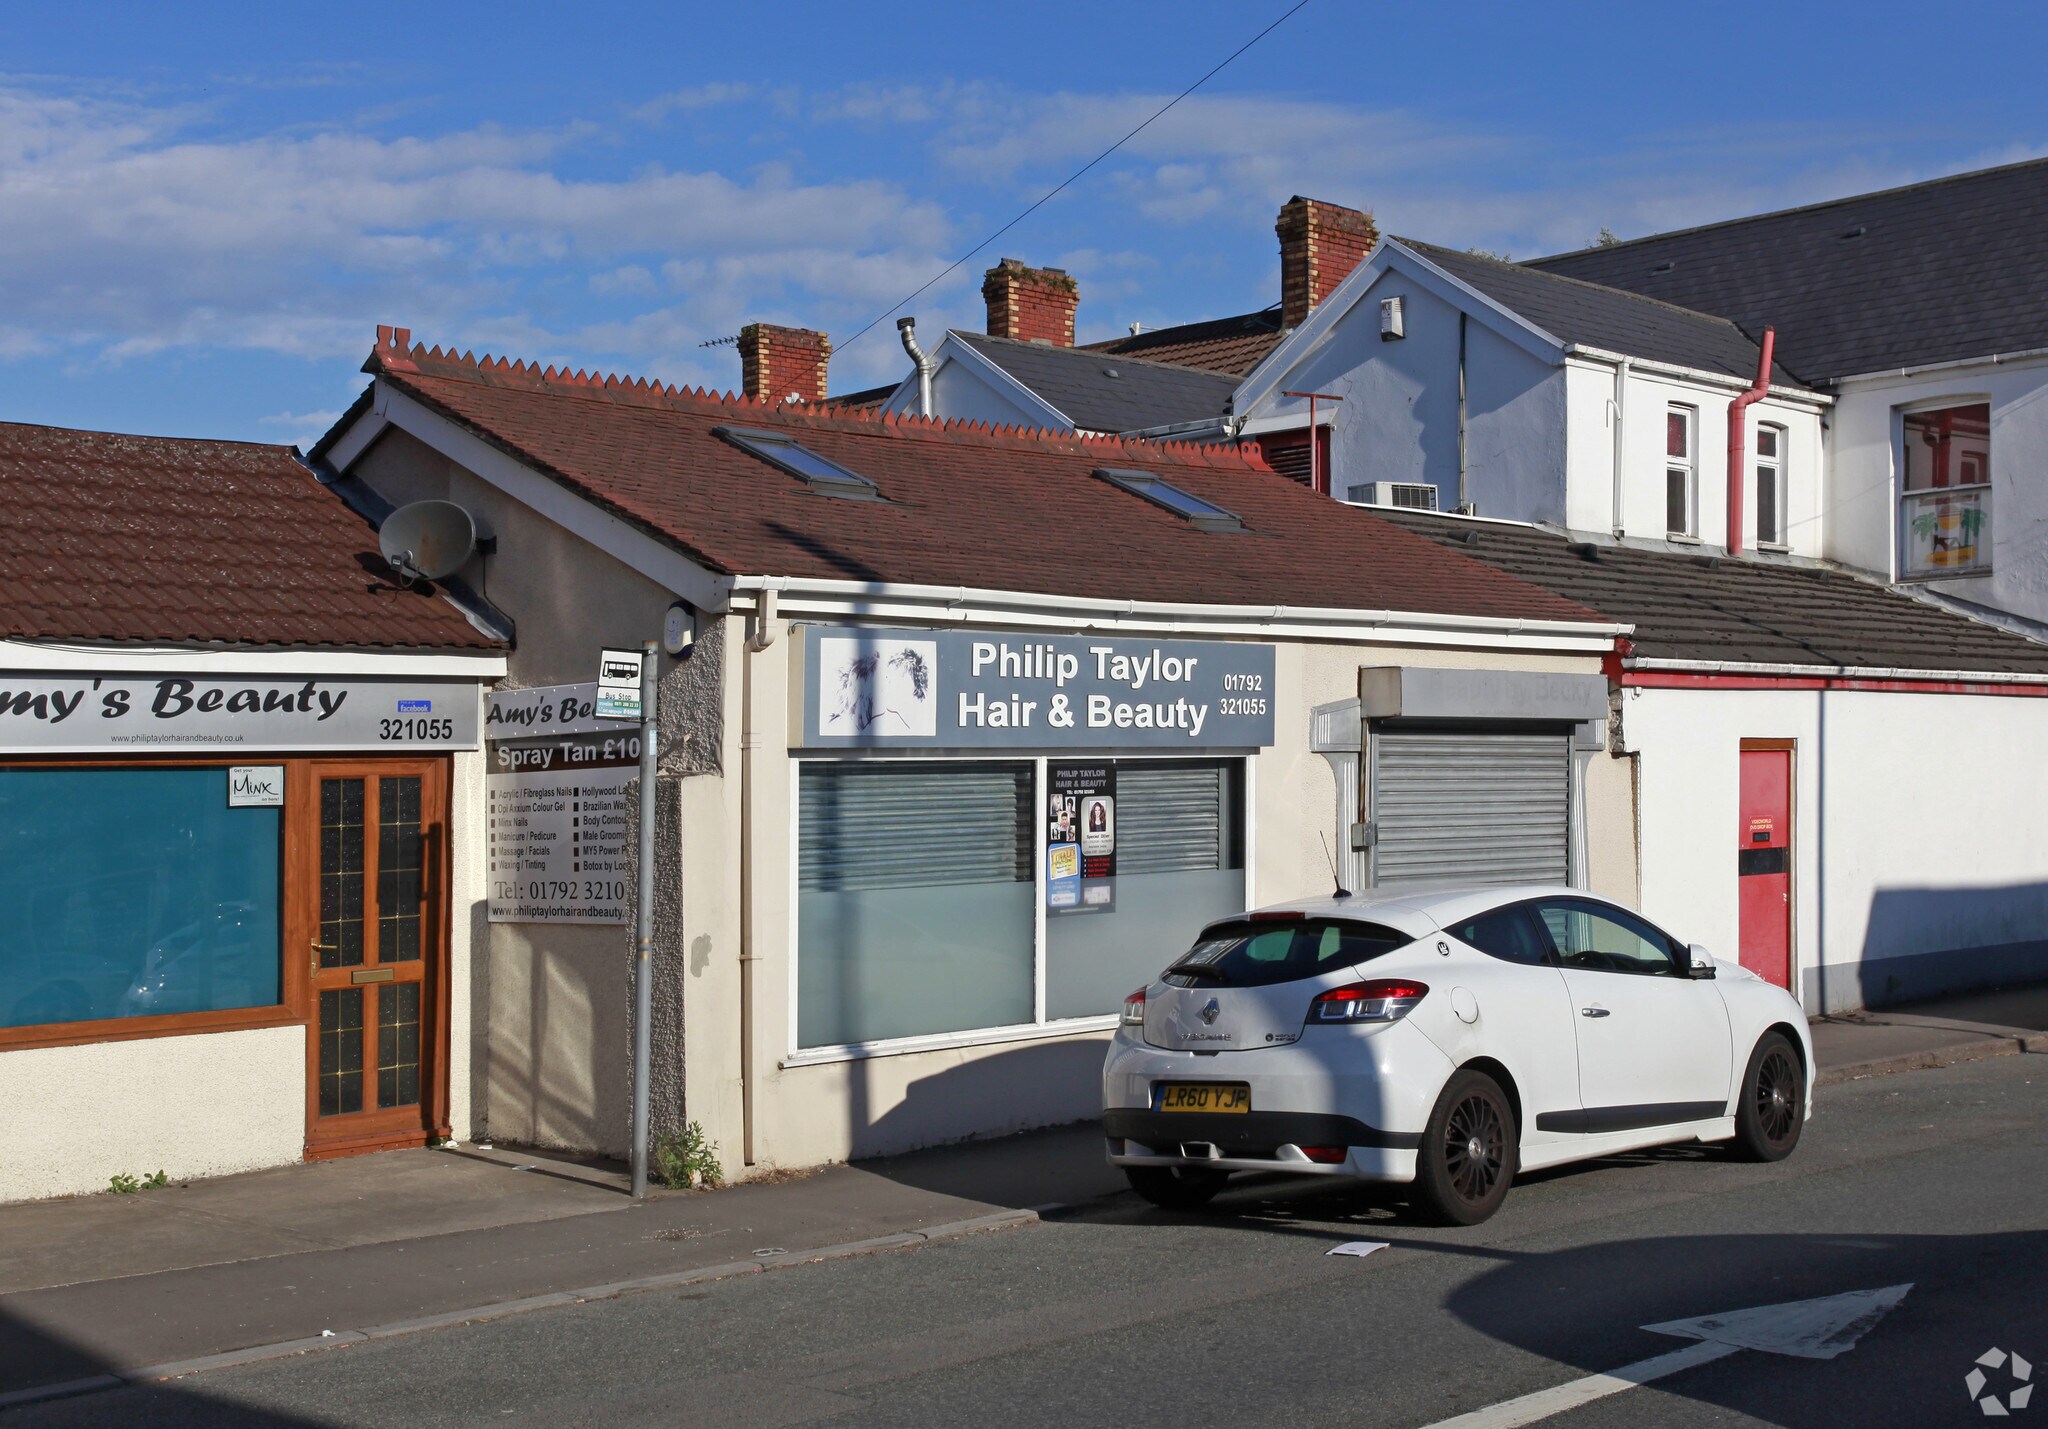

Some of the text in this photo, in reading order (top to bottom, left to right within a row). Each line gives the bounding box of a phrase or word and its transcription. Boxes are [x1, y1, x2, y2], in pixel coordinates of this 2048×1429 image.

[972, 642, 1198, 690] Philip Taylor
[1223, 673, 1262, 692] 01792
[0, 677, 348, 724] my's Beauty
[618, 692, 632, 701] Stop
[400, 704, 428, 712] facebook
[486, 695, 553, 727] Amy's
[1219, 697, 1266, 716] 321055
[957, 692, 1208, 737] Hair & Beauty
[379, 718, 453, 740] 321055
[111, 733, 244, 743] www.philiptaylorhairandbeauty.co.uk
[498, 737, 640, 770] Spray Tan £10
[1056, 769, 1106, 778] PHILIP TAYLOR
[1055, 780, 1073, 788] HAIR
[1080, 779, 1107, 787] BEAUTY
[498, 788, 519, 801] Acrylic
[523, 787, 555, 800] Fibreglass
[556, 786, 573, 798] Nails
[582, 785, 617, 798] Hollywood
[498, 801, 566, 815] Opi Axxium Colour Gel
[583, 801, 612, 811] Brazilian
[498, 817, 529, 827] Minx Nails
[583, 815, 600, 828] Body
[498, 832, 525, 842] Manicure
[529, 831, 557, 841] Pedicure
[583, 830, 627, 841] Male Groomi
[499, 846, 524, 858] Massage
[528, 845, 551, 856] Facials
[583, 845, 598, 856] MY5
[599, 845, 620, 856] Power
[499, 860, 520, 871] Waxing
[525, 860, 546, 872] Tinting
[583, 860, 603, 871] Botox
[604, 860, 613, 873] by
[494, 881, 524, 900] Tel:
[529, 881, 578, 900] 01792
[1165, 1087, 1248, 1108] LR60 YJP
